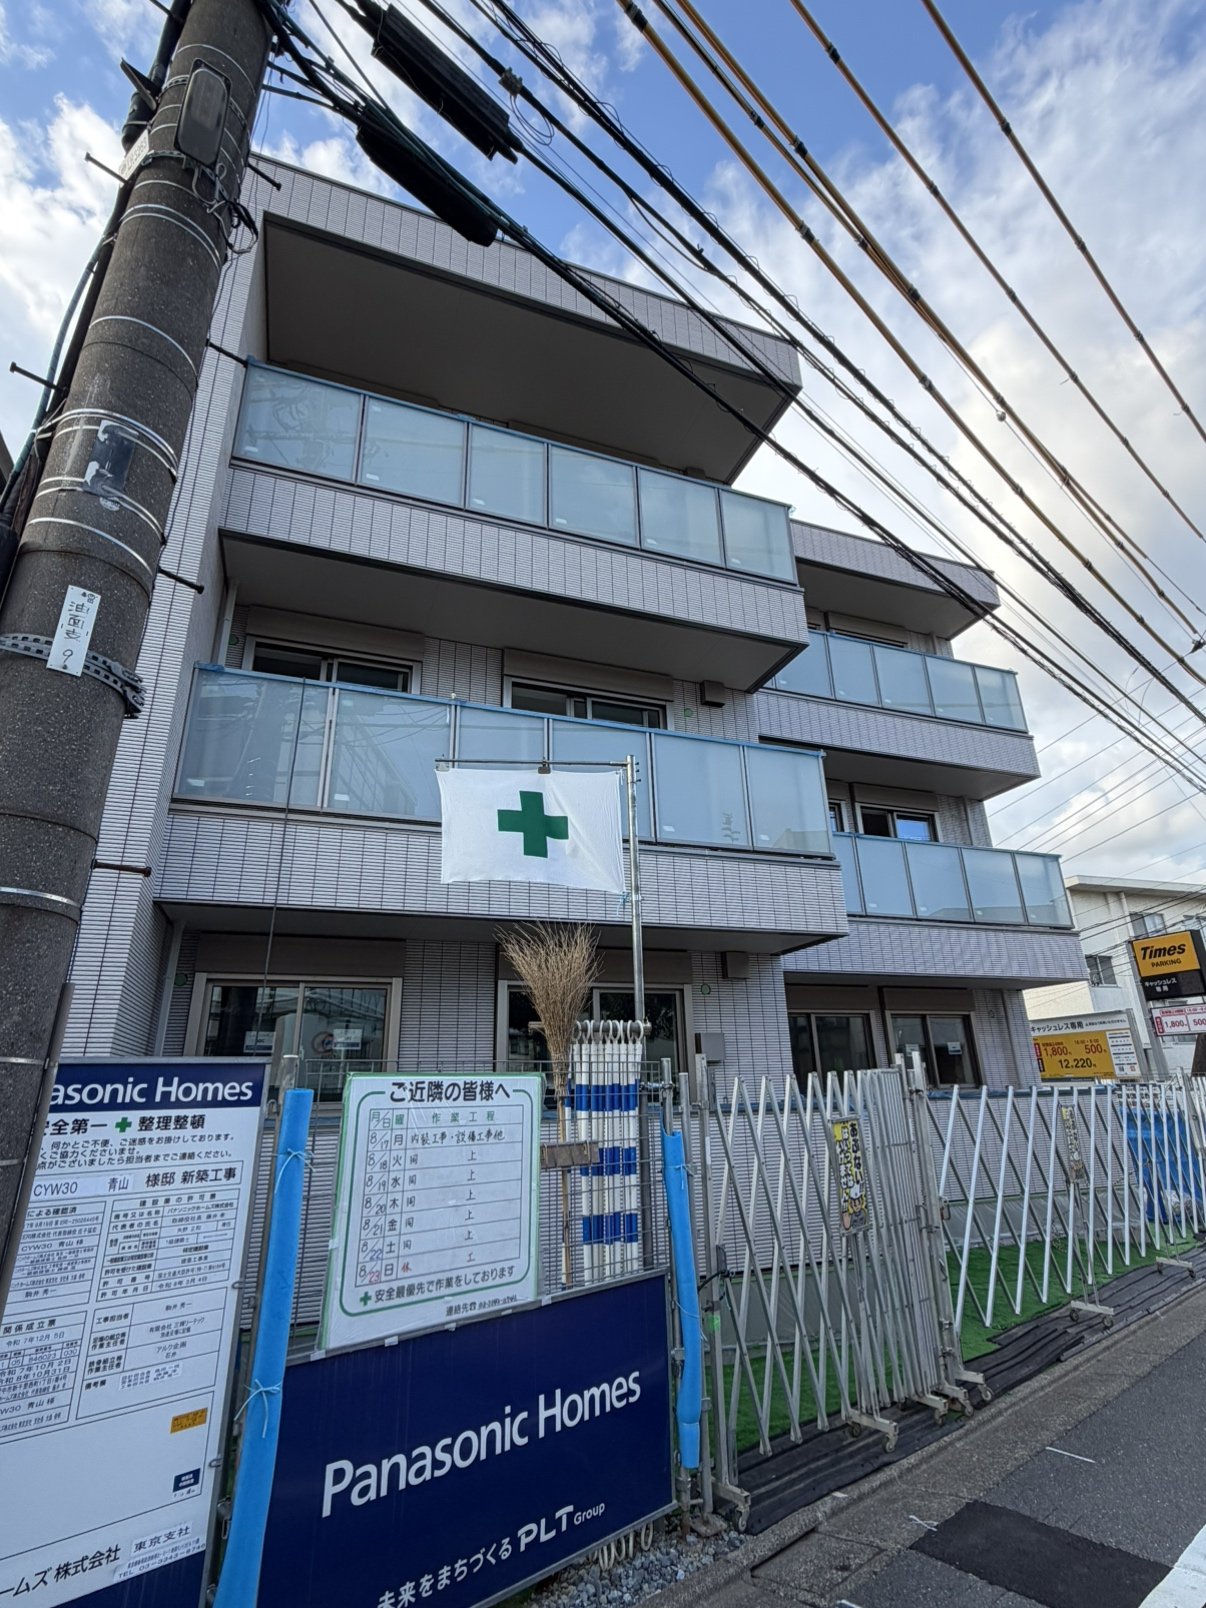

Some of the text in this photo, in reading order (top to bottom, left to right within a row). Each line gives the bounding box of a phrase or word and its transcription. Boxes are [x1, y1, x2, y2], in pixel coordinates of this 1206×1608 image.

[62, 649, 74, 663] 9
[1140, 942, 1187, 961] Times
[1151, 957, 1182, 968] PARKING
[1030, 1020, 1085, 1034] キャッシュレス専用
[155, 1077, 254, 1103] Homes
[389, 1080, 511, 1103] ご近隣の皆様へ
[138, 1114, 206, 1133] 整理整頓
[432, 1111, 496, 1124] 作業工程
[393, 1134, 404, 1146] 月
[392, 1155, 403, 1168] 火
[33, 1166, 237, 1197] CYW30 青山 様邸 新築工事
[390, 1176, 401, 1189] 水
[389, 1197, 400, 1210] 木
[387, 1218, 398, 1233] 金
[386, 1241, 396, 1255] 土
[384, 1262, 394, 1277] 日
[321, 1370, 642, 1519] Panasonic Homes
[133, 1525, 190, 1552] 東京支社
[376, 1501, 606, 1608] 未来をまちづくる PLT Group
